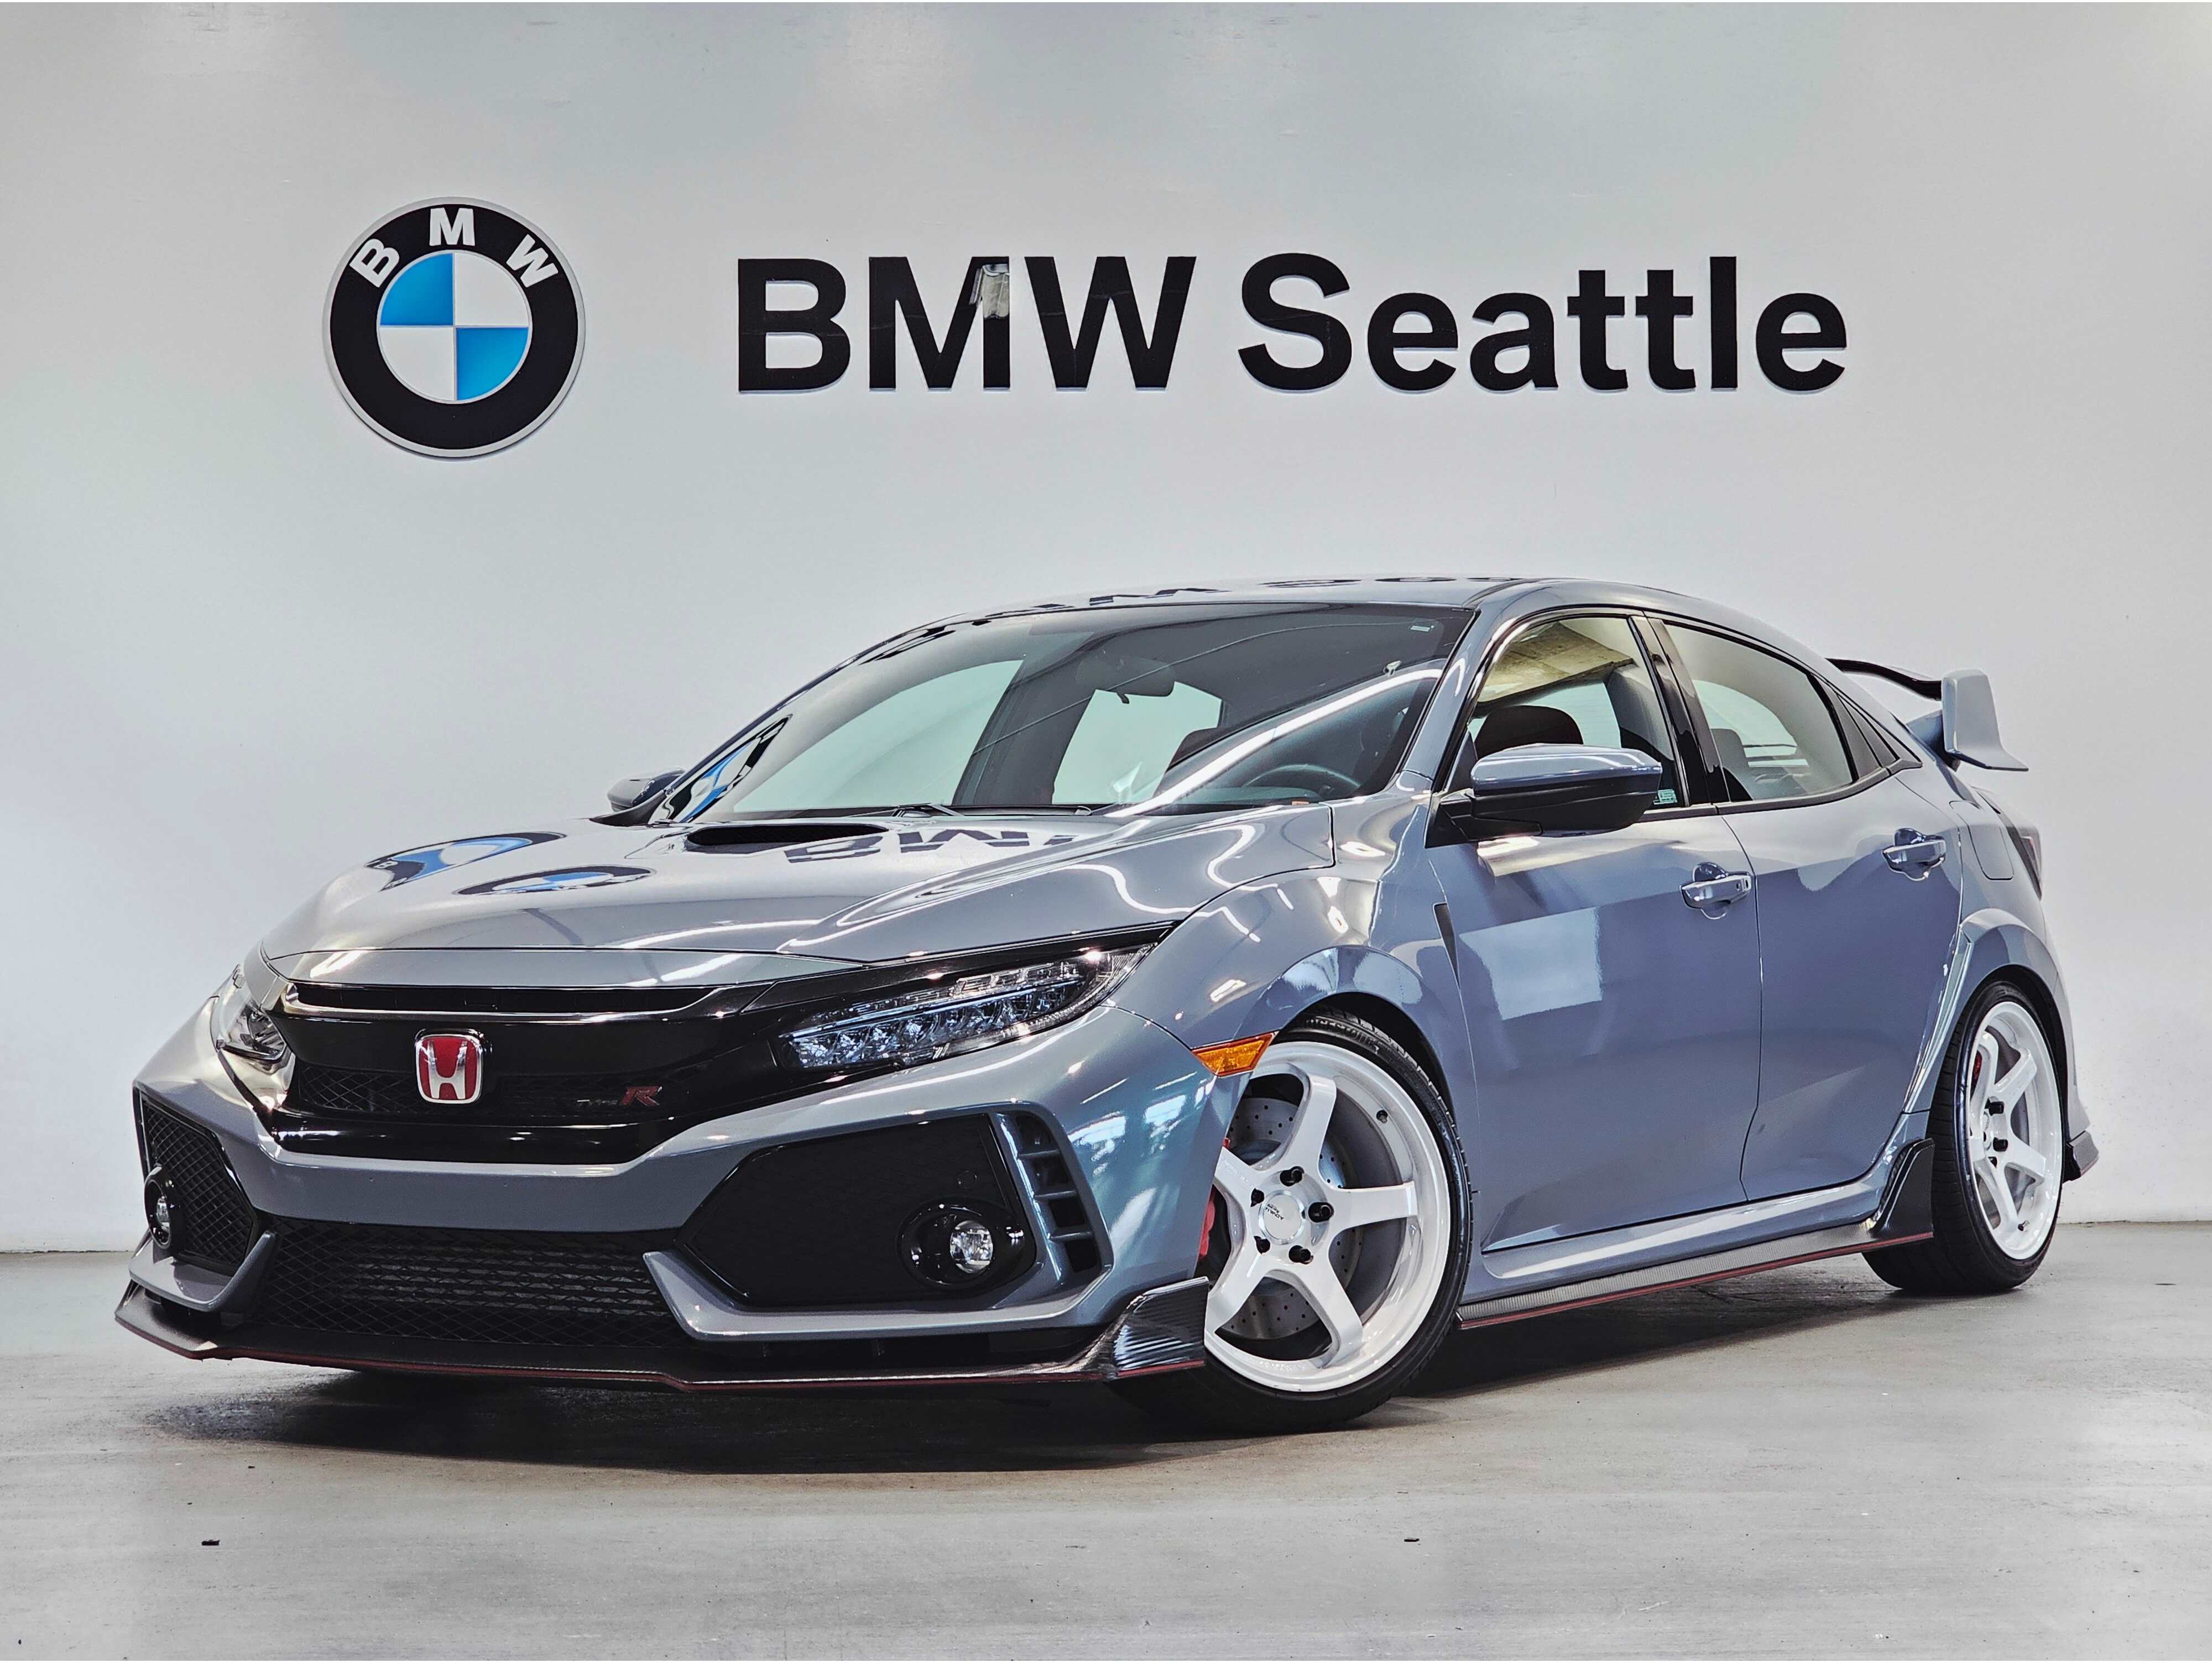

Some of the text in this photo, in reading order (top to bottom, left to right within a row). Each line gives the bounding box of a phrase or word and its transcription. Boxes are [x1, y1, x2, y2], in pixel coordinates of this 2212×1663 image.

[349, 207, 559, 288] BMW
[738, 253, 1847, 392] BMW Seattle
